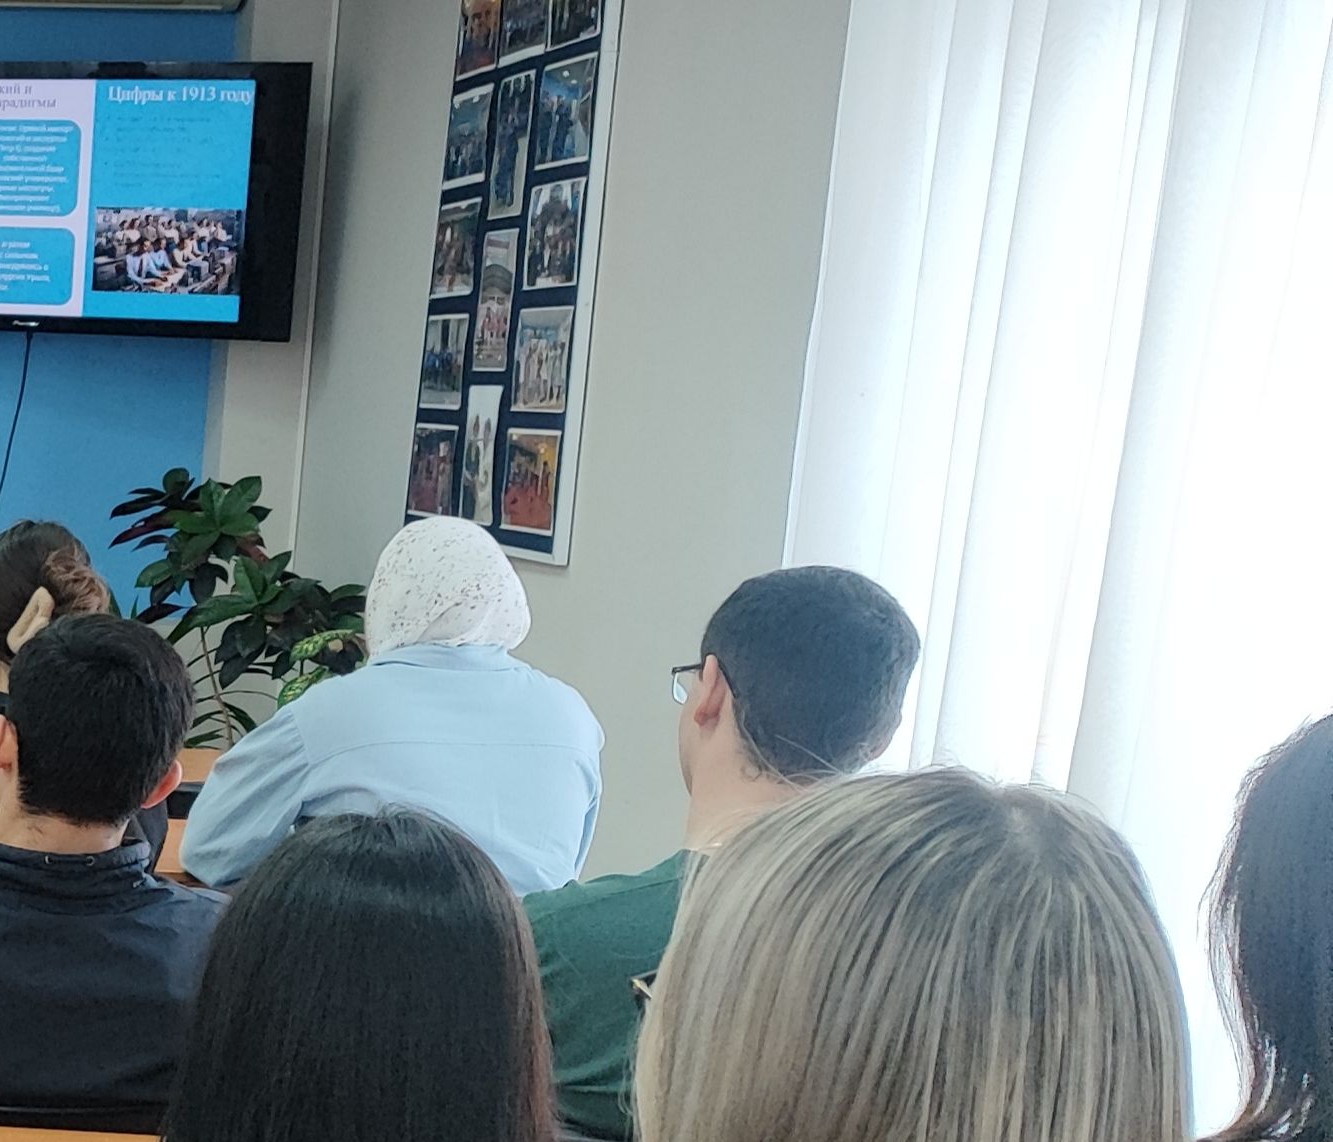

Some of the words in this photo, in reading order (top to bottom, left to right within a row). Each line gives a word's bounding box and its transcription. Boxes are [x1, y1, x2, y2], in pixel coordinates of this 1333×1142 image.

[24, 84, 33, 94] и
[108, 85, 164, 105] Цифры
[167, 90, 177, 101] к
[182, 86, 216, 102] 1913
[220, 90, 254, 105] году
